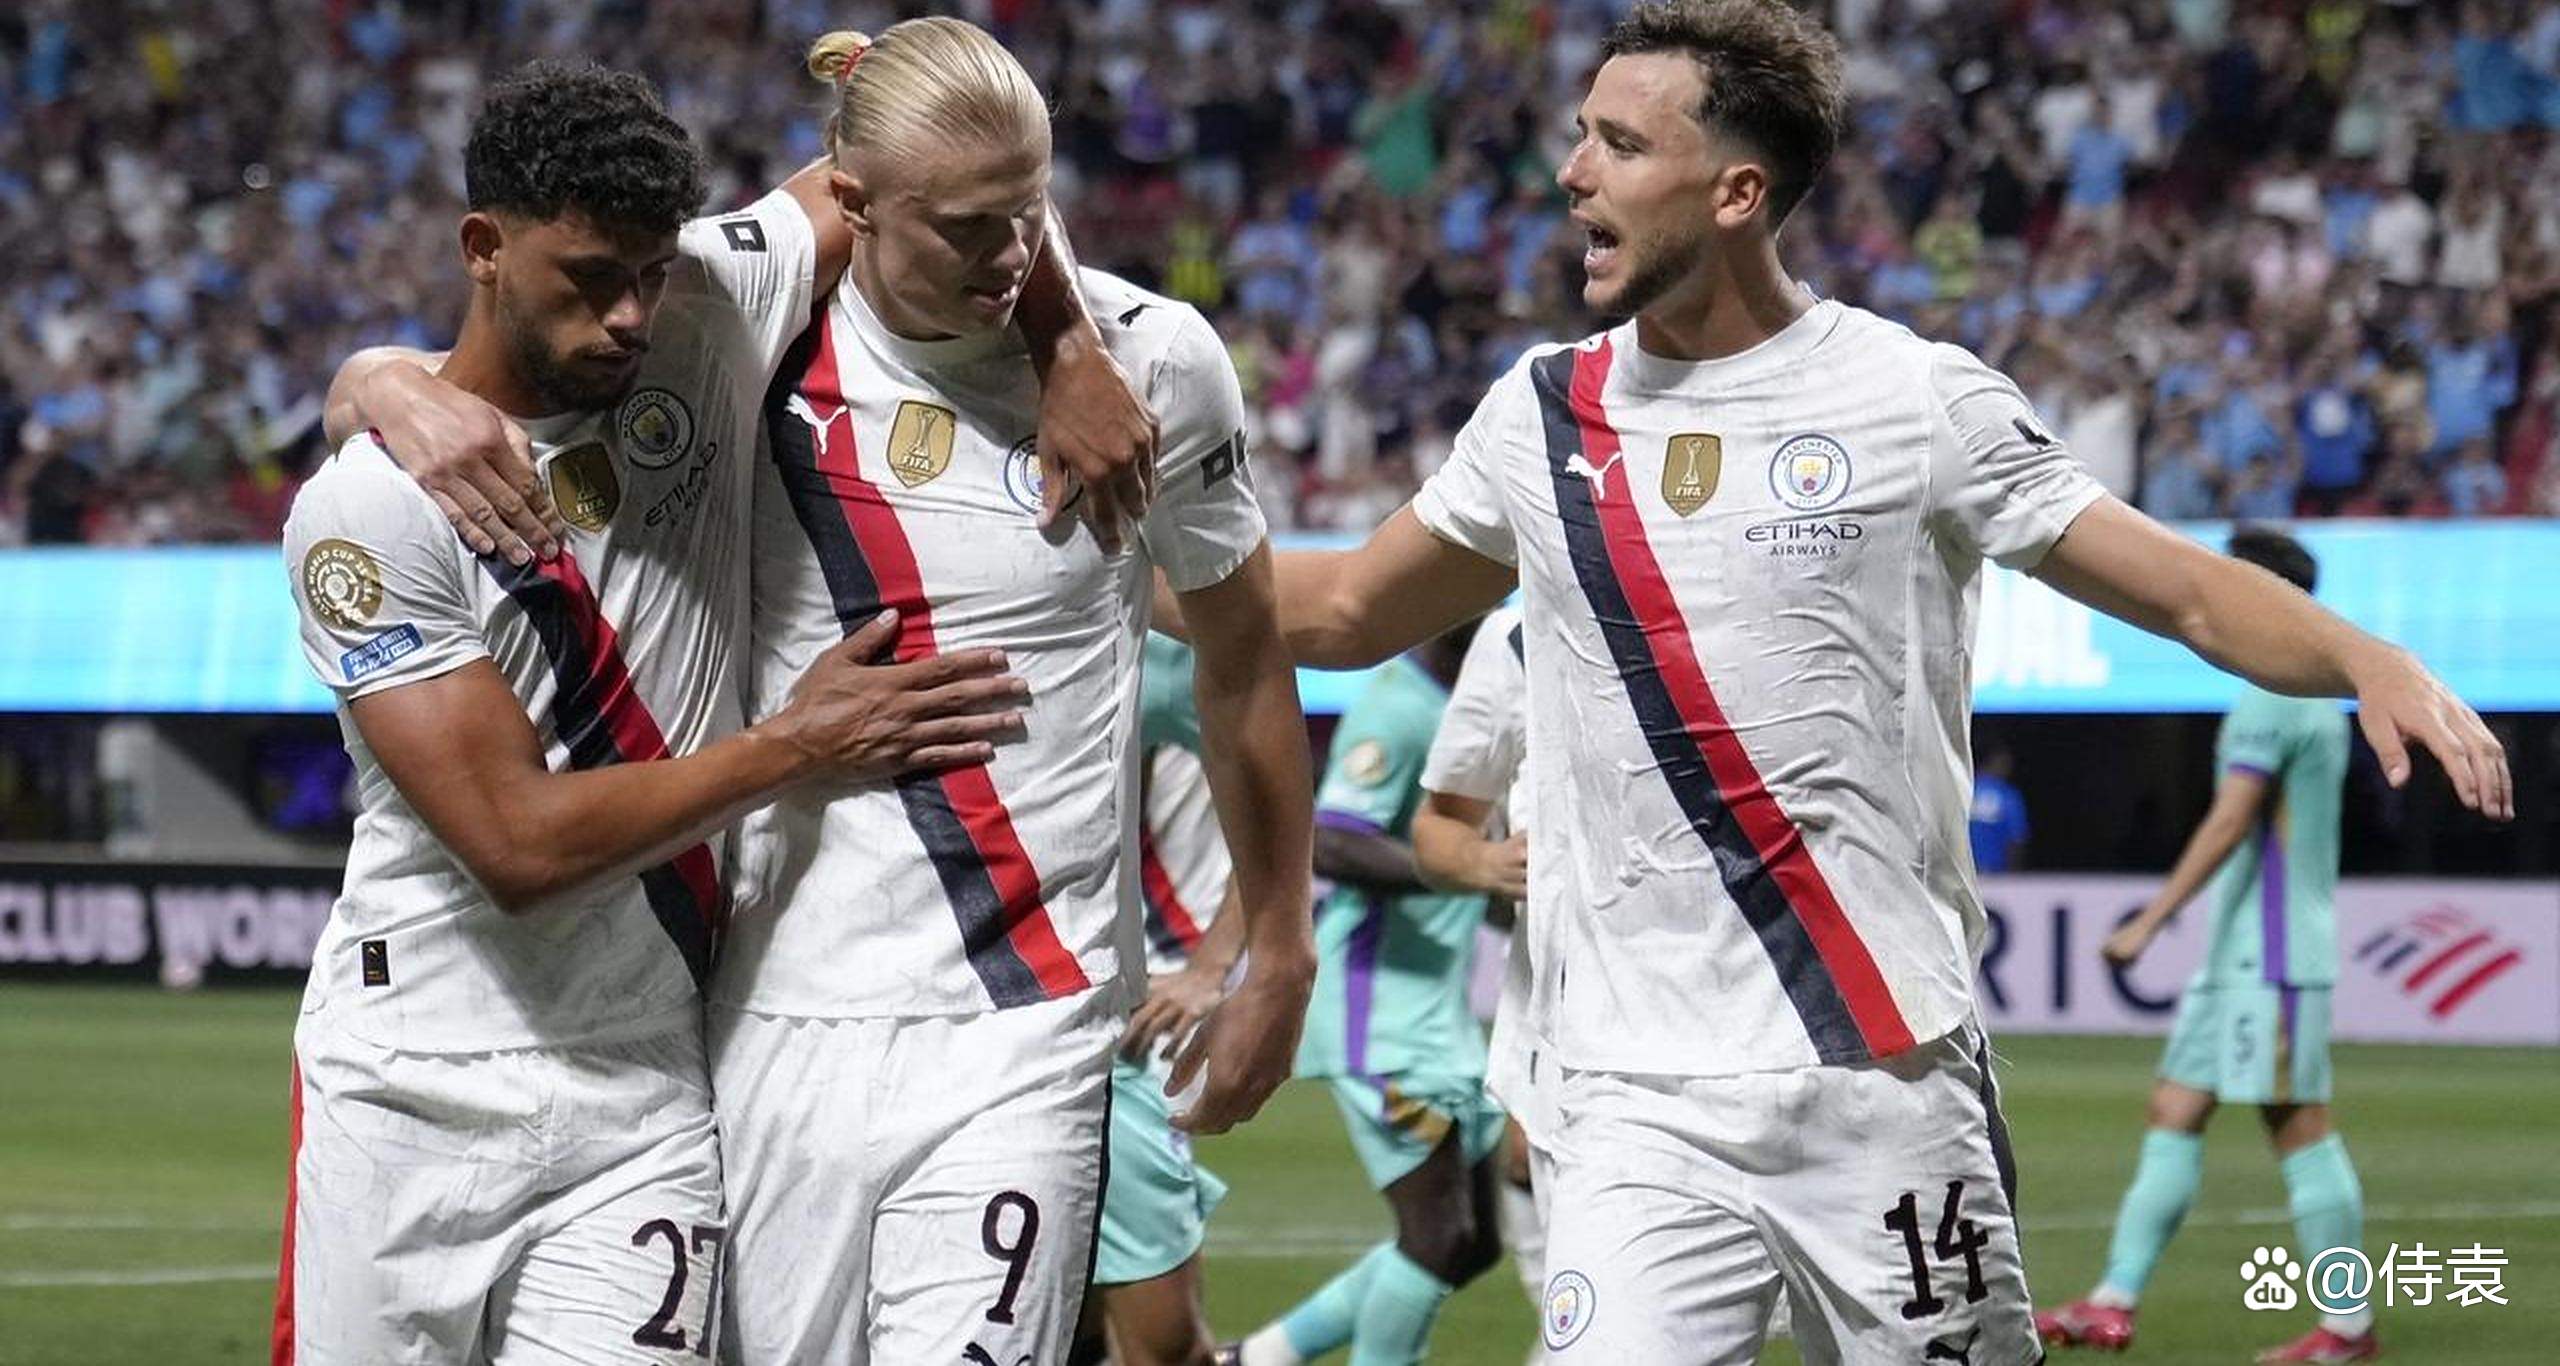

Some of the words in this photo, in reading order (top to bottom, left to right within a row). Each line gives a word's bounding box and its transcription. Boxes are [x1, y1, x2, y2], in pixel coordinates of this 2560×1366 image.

[901, 454, 931, 471] FIFA
[1673, 485, 1702, 498] FIFA
[1745, 523, 1863, 543] ETIHAD
[1769, 545, 1838, 557] AIRWAYS
[0, 884, 146, 966] CLUB
[982, 1190, 1040, 1326] 9
[1884, 1180, 1989, 1321] 14
[632, 1218, 726, 1358] 27
